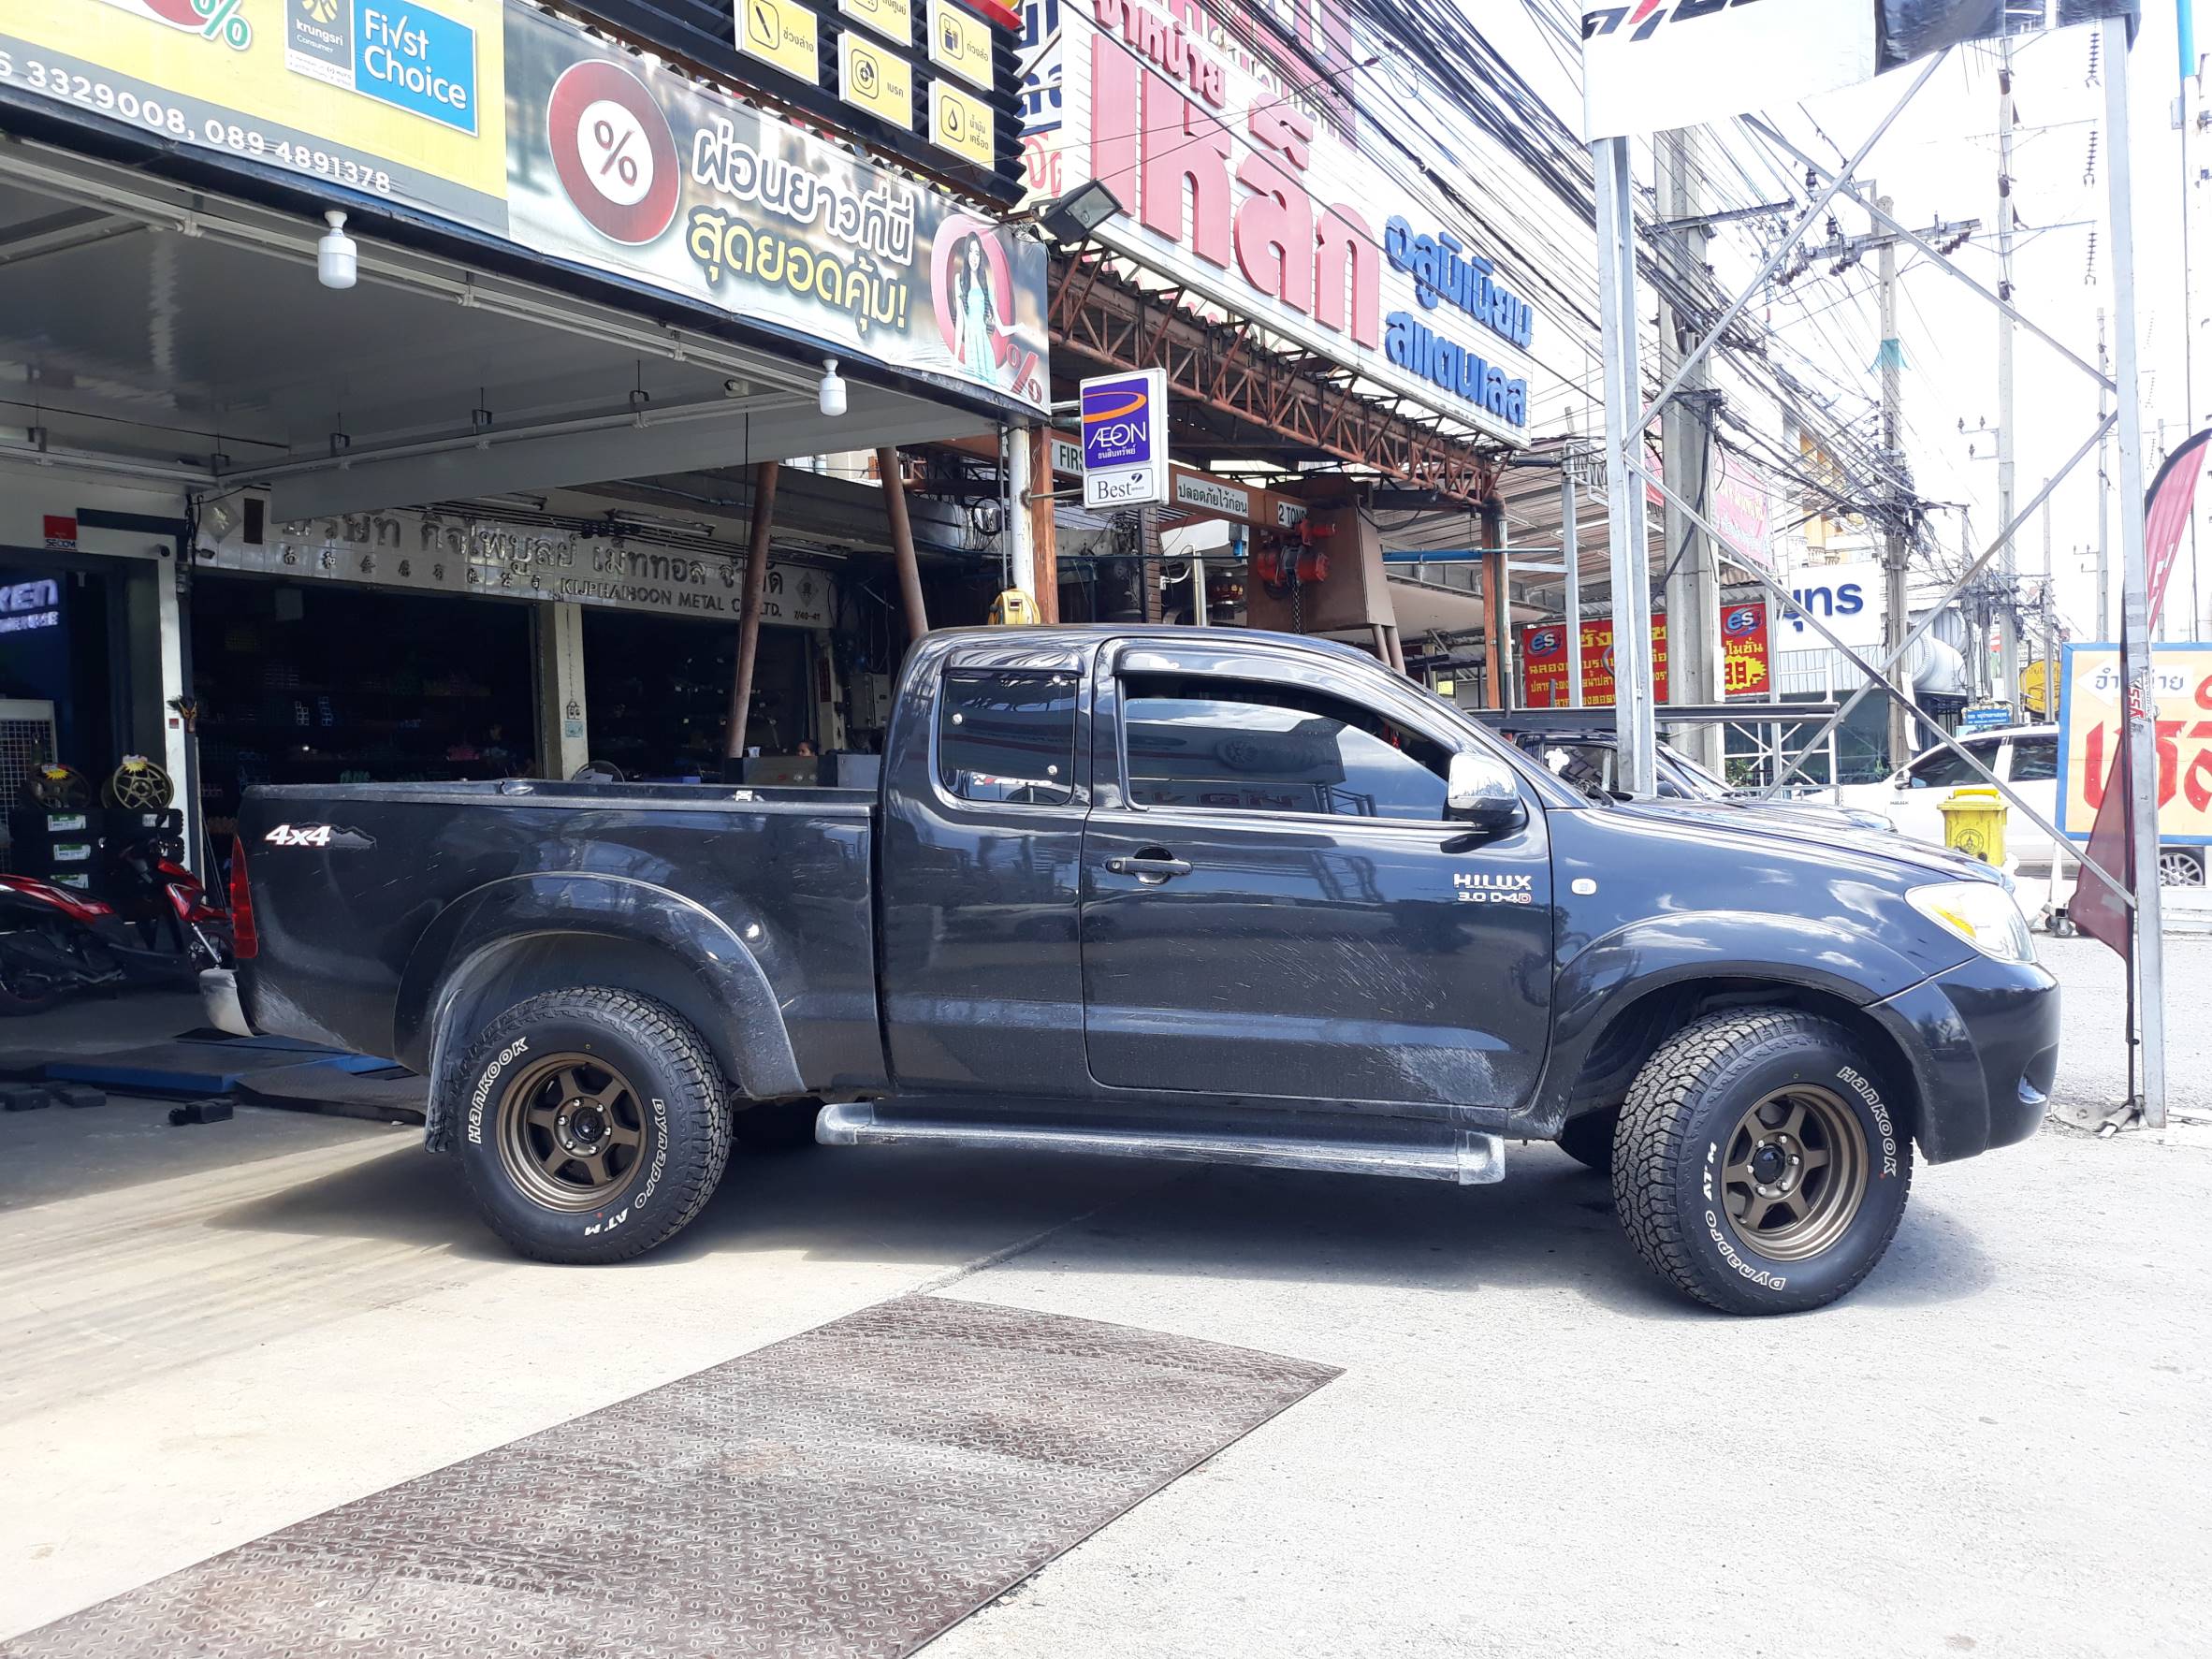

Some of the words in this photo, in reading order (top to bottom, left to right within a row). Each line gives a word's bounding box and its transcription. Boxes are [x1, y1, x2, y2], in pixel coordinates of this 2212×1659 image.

[296, 18, 344, 46] krungsri
[782, 26, 814, 52] ช่วงล่าง
[296, 34, 334, 53] Consumer
[967, 41, 989, 62] ถ่วงล้อ
[364, 45, 467, 109] Choice
[887, 82, 904, 97] เบรก
[26, 60, 196, 141] 3329008,
[204, 119, 265, 156] 089
[275, 141, 391, 194] 4891378
[969, 114, 986, 135] น้ำมัน
[969, 132, 989, 151] เครื่อง
[694, 123, 912, 263] ผ่อนยาวที่นี่
[1091, 33, 1380, 351] เหล็ก
[690, 211, 909, 333] สุดยอดคุ้ม!
[1384, 214, 1533, 350] อลูมิเนียม
[1384, 311, 1527, 428] สแตนเลส
[1098, 444, 1137, 459] ธนสินทรัพย์
[1097, 480, 1131, 500] Best
[1178, 483, 1248, 515] ปลอดภัยไว้ก่อน
[1278, 503, 1285, 523] 2
[677, 591, 724, 611] METAL
[264, 824, 331, 847] 4x4
[1453, 873, 1532, 889] HILUX
[1490, 892, 1532, 904] D-4D
